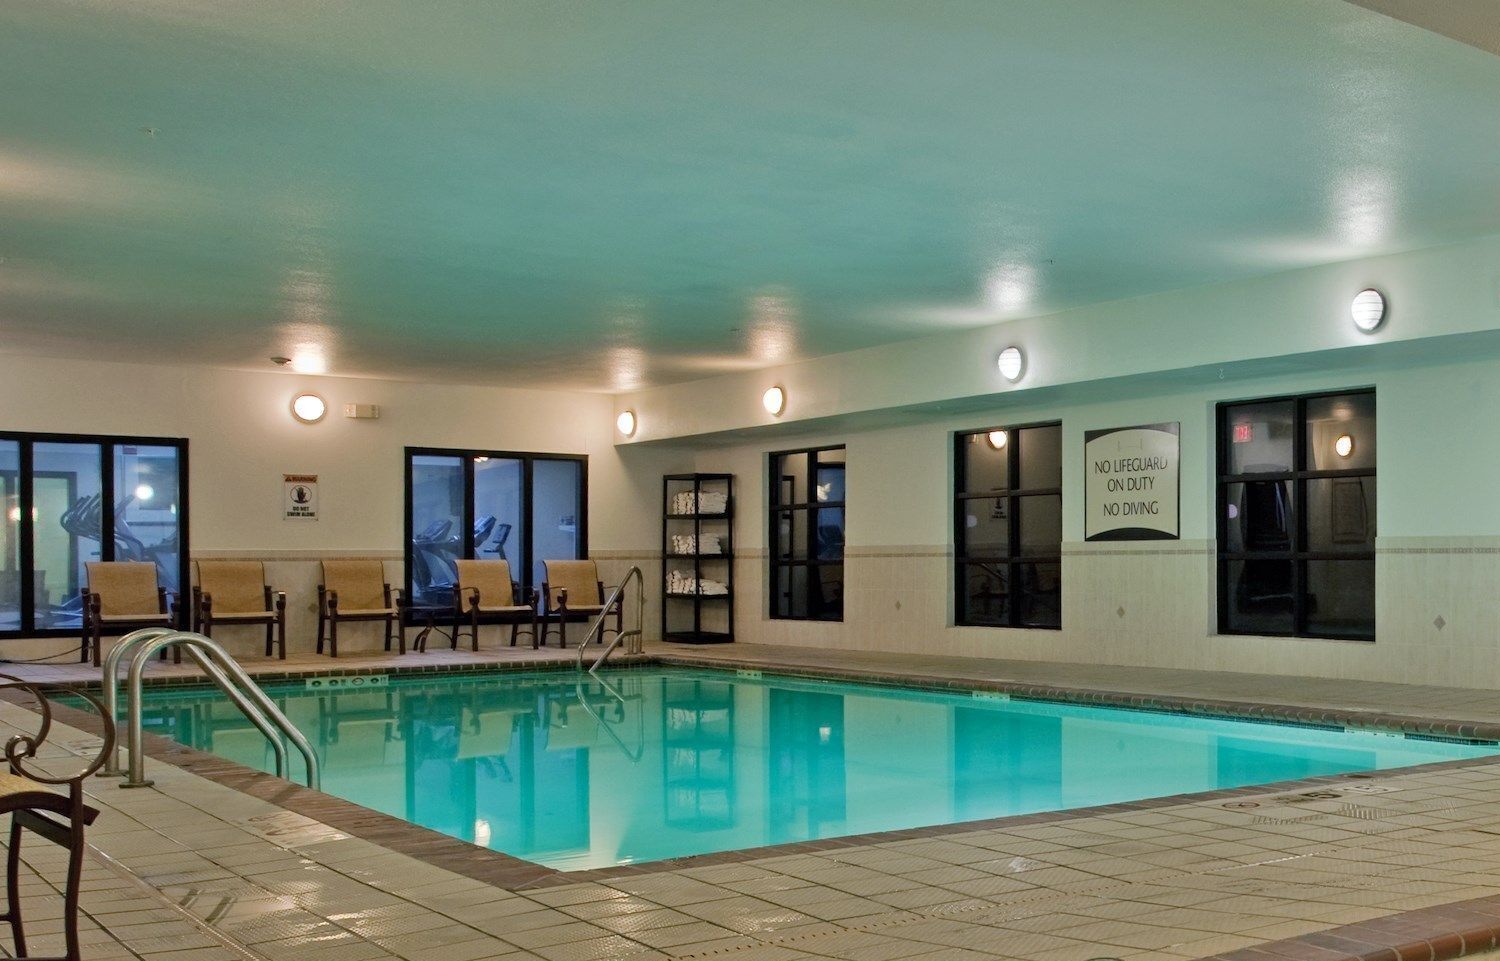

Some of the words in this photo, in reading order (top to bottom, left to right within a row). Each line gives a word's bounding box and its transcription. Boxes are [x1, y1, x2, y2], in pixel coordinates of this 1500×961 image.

[1094, 460, 1111, 474] NO
[1114, 456, 1168, 473] LIFEGUARD
[1107, 478, 1124, 492] ON
[1127, 476, 1155, 491] DUTY
[1103, 502, 1120, 516] NO
[1123, 500, 1159, 516] DIVING
